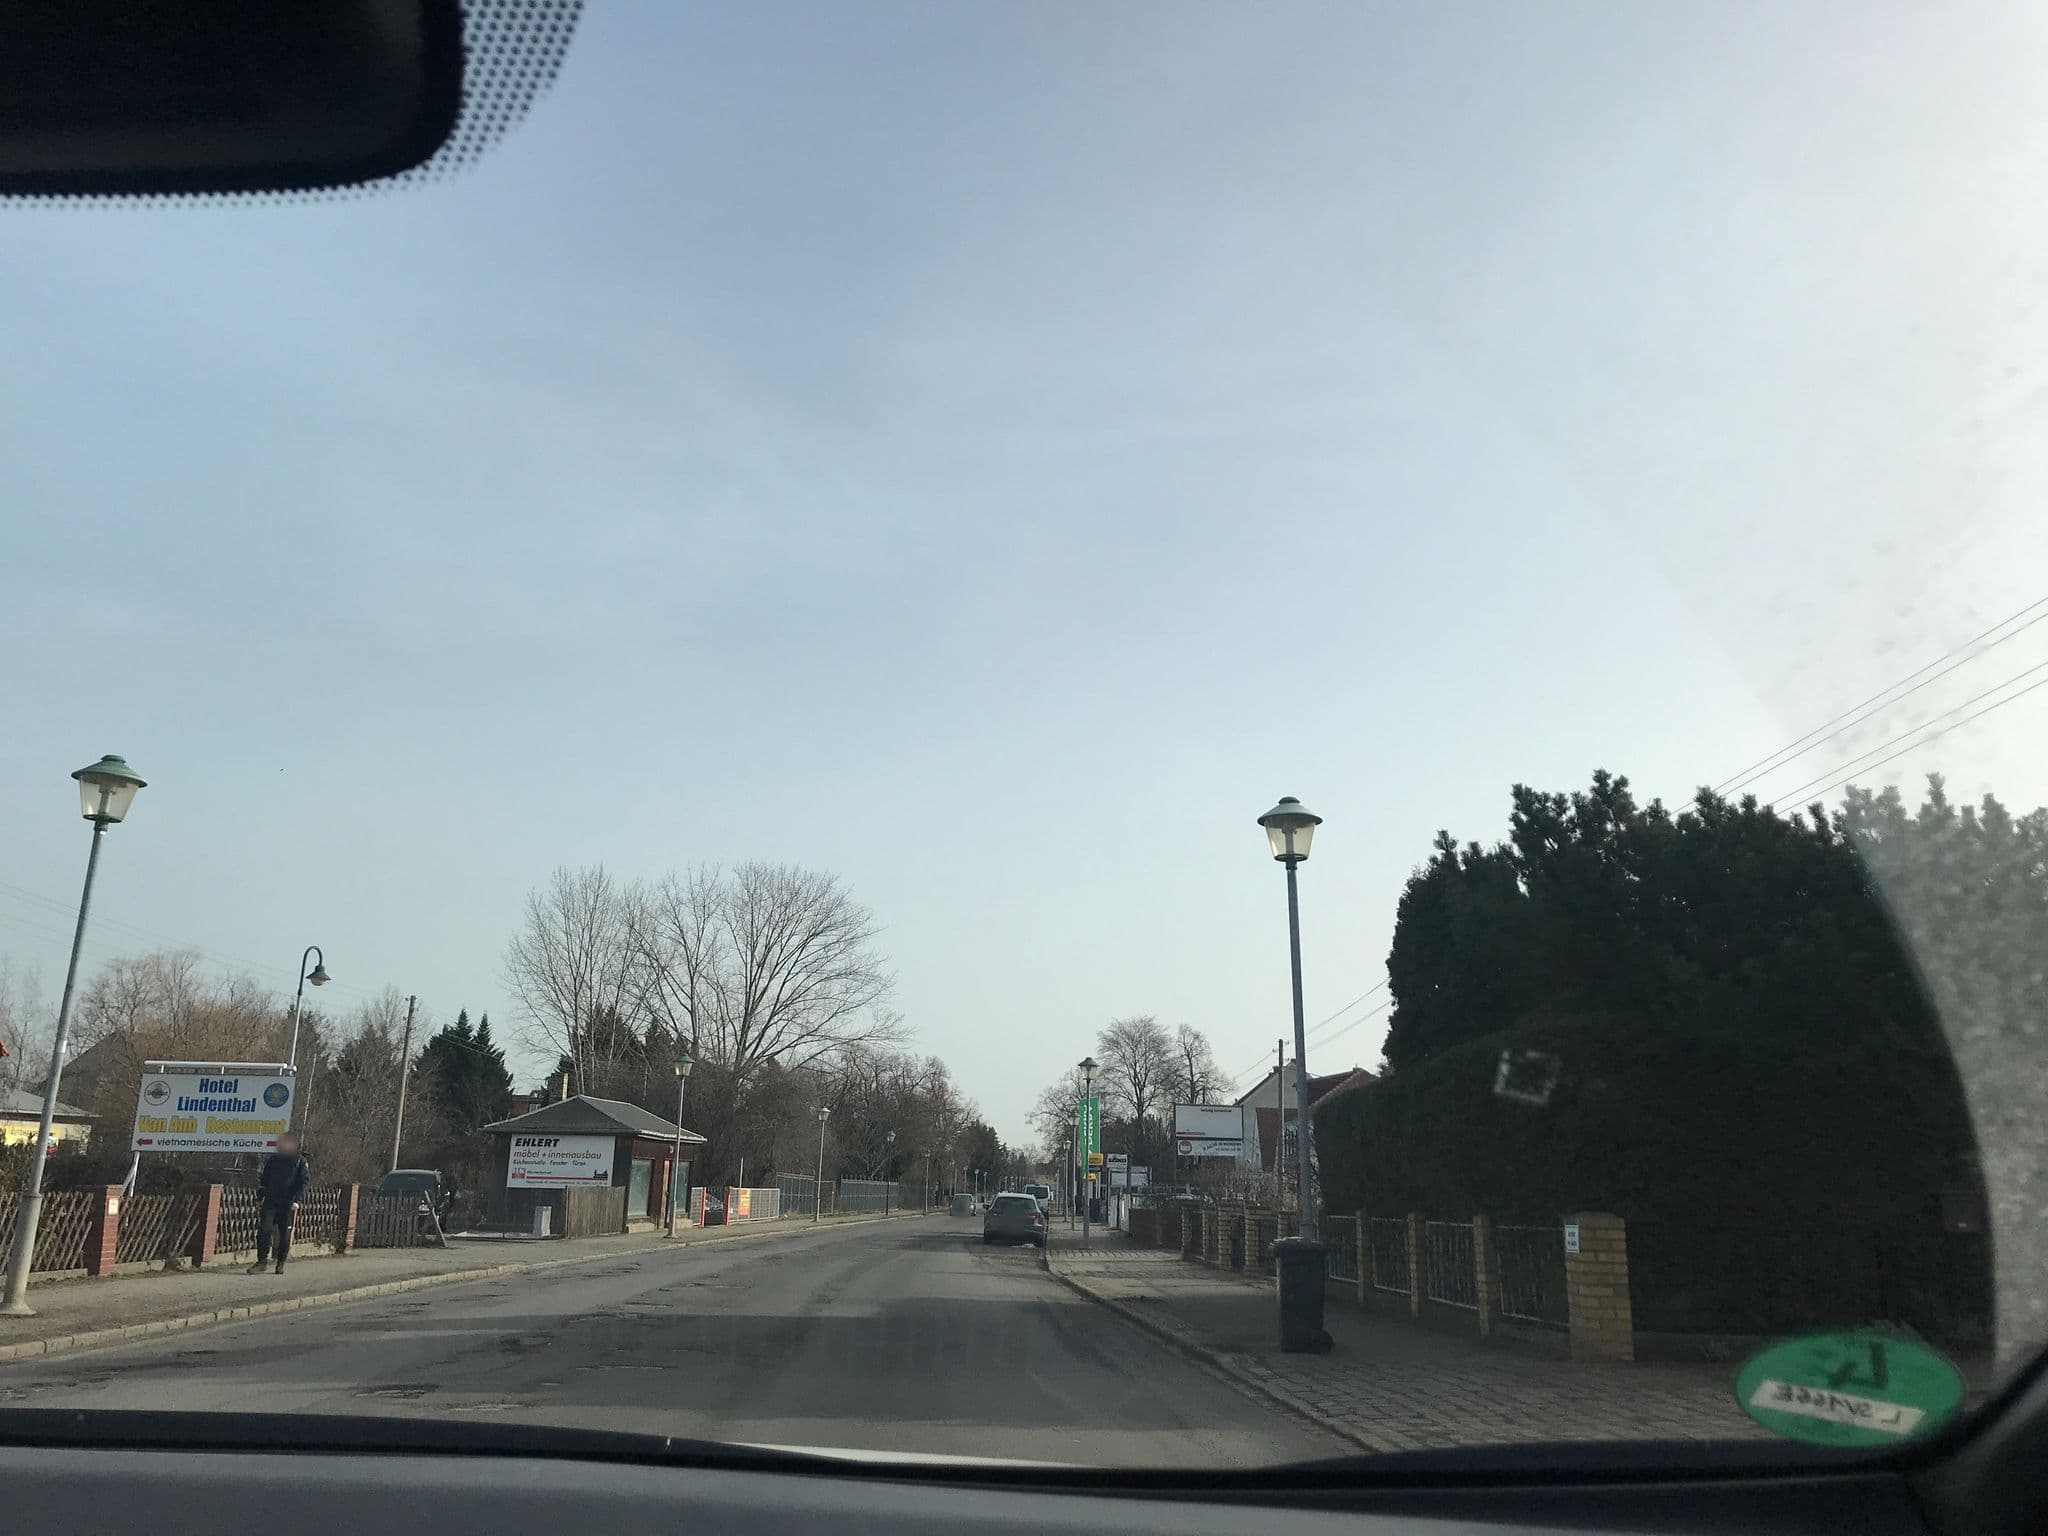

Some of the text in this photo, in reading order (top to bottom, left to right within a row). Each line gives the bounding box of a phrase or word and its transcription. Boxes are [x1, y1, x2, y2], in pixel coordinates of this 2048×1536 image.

[199, 1078, 239, 1094] Hotel
[177, 1096, 257, 1112] Lindenthal
[139, 1115, 167, 1133] Van
[206, 1116, 286, 1135] Restaurant
[157, 1138, 263, 1148] vietnamesische Küche
[515, 1138, 560, 1148] EHLERT
[513, 1149, 540, 1158] möbel
[548, 1150, 602, 1160] innenausbau
